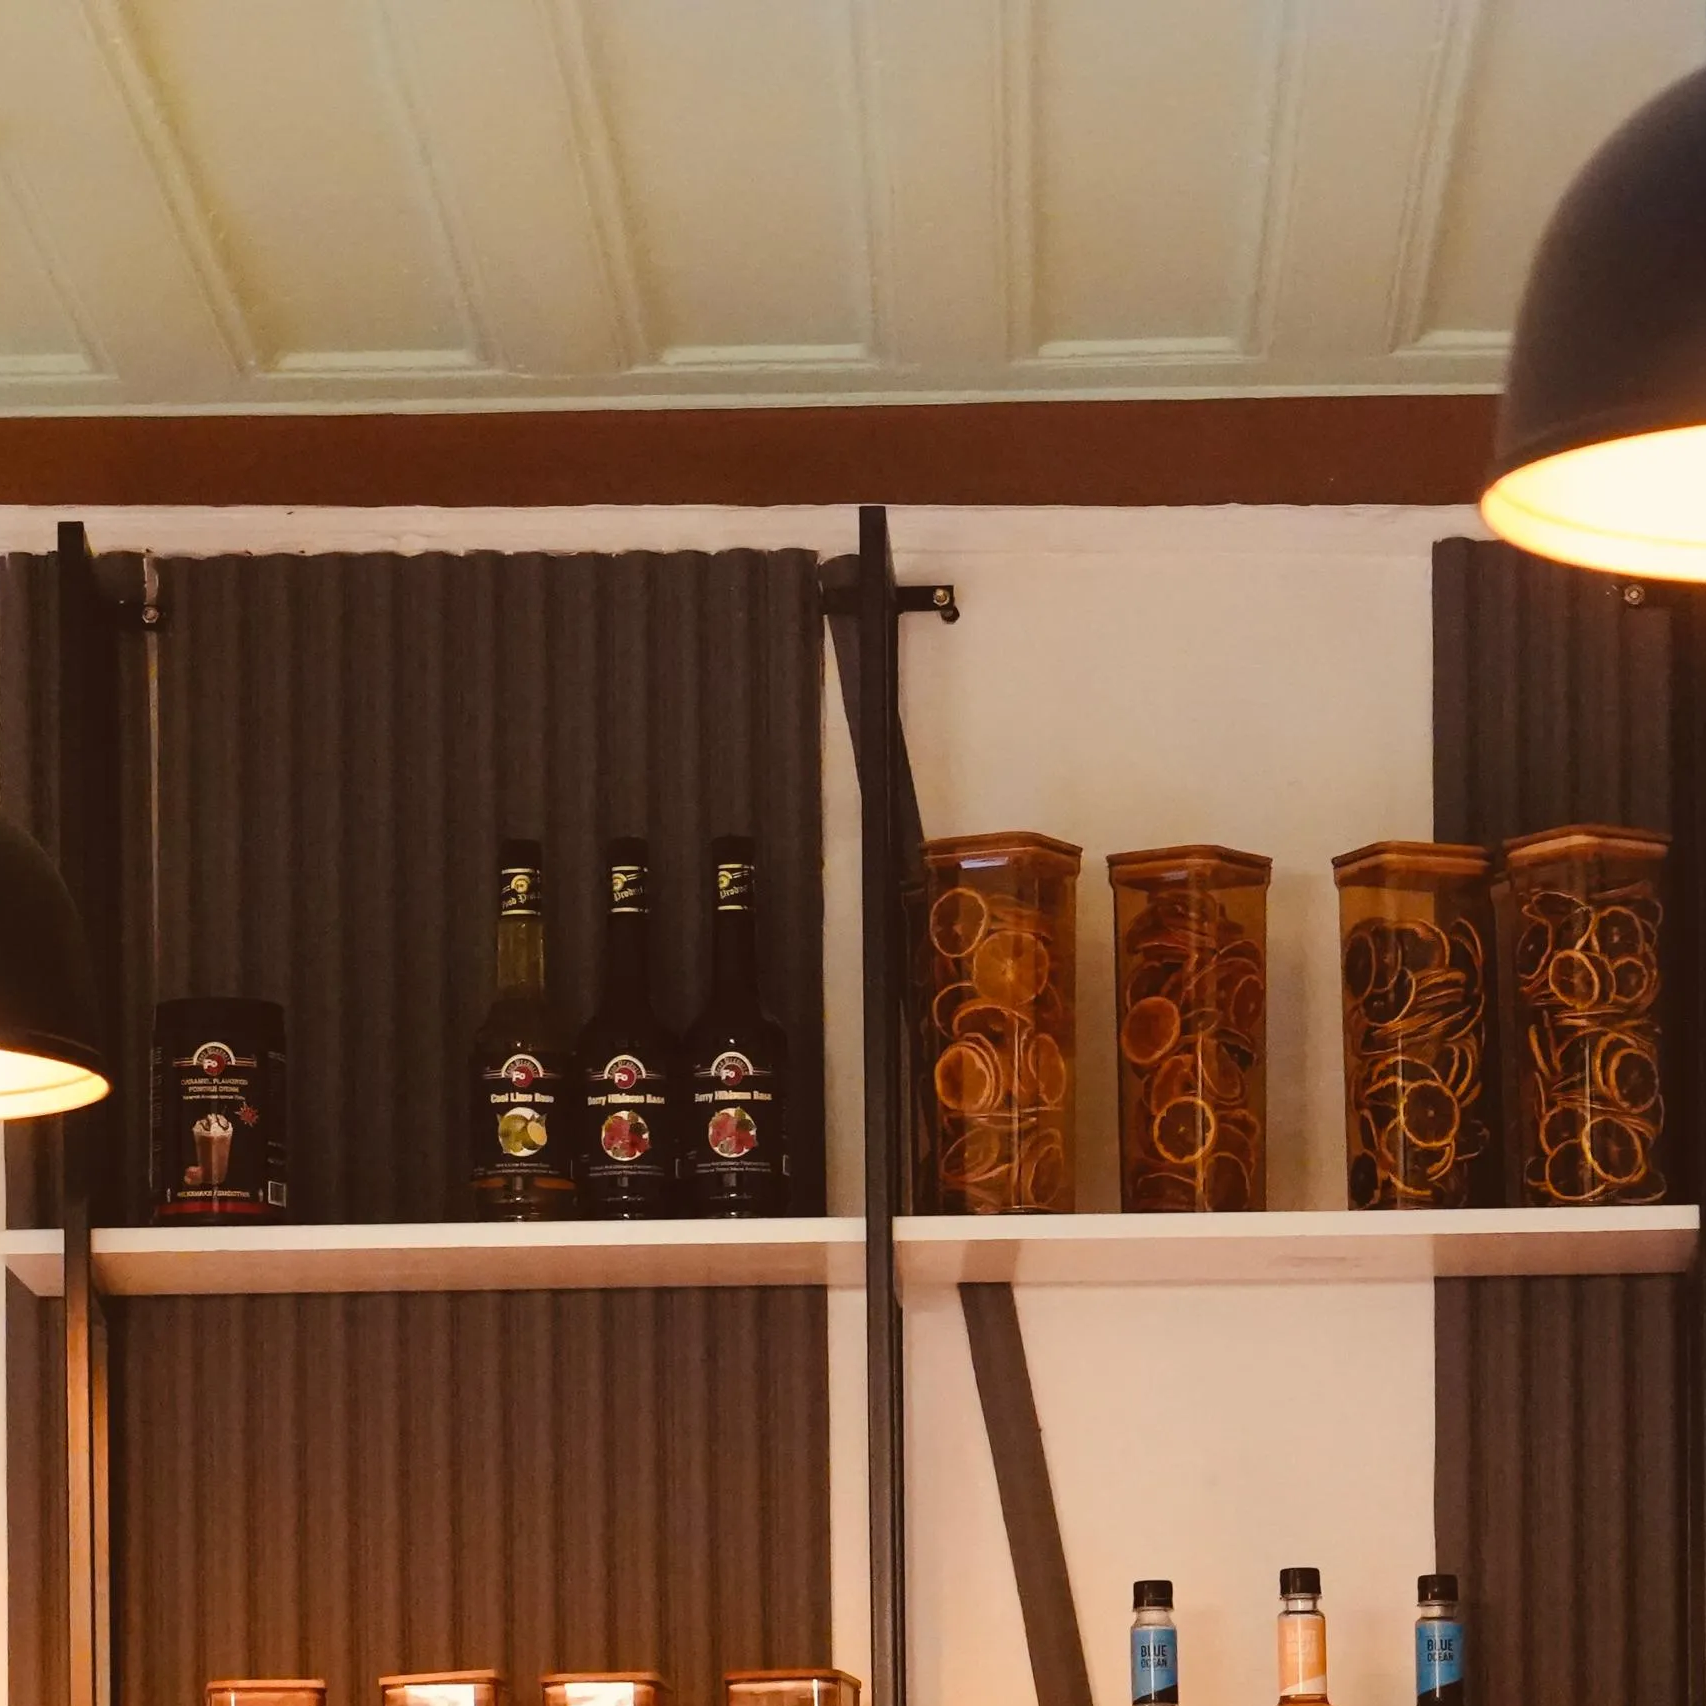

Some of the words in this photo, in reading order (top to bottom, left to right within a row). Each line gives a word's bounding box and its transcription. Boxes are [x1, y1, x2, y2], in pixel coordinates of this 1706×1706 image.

[490, 1093, 509, 1103] Cool
[510, 1092, 533, 1102] Lime
[1140, 1644, 1167, 1658] BLUE
[1427, 1639, 1453, 1651] BLUE
